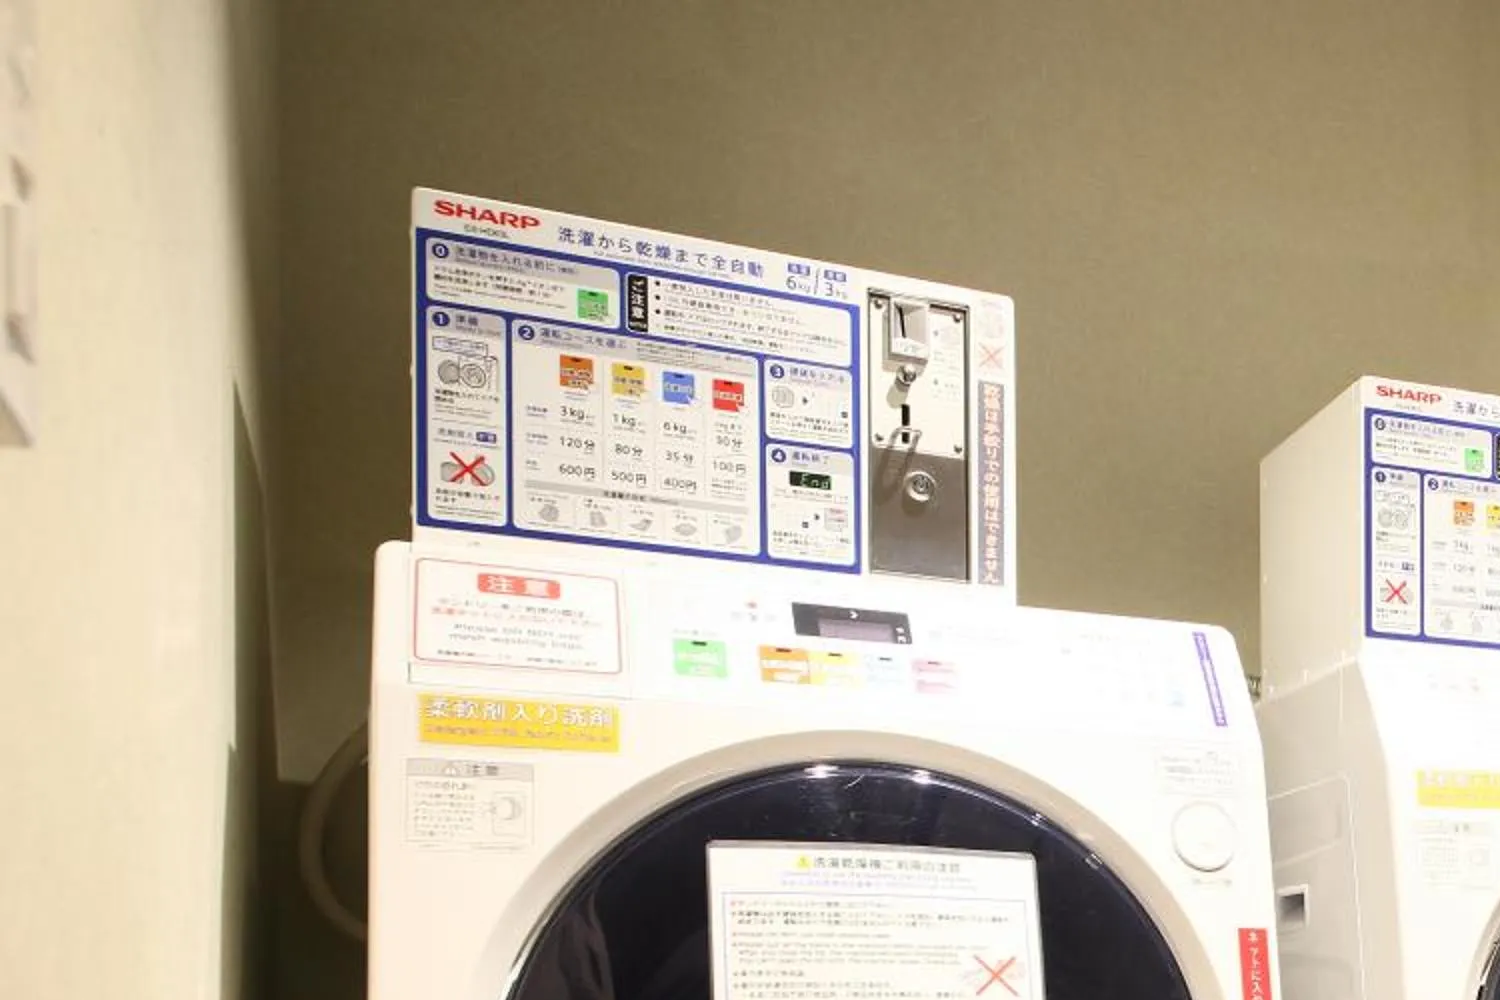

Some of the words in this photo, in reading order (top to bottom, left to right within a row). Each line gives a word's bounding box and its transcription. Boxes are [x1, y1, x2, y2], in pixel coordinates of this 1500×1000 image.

[433, 200, 541, 229] SHARP
[558, 226, 765, 279] 洗濯から乾燥まで全自動
[1375, 384, 1443, 405] SHARP
[559, 464, 595, 479] 600円
[611, 471, 647, 485] 500円
